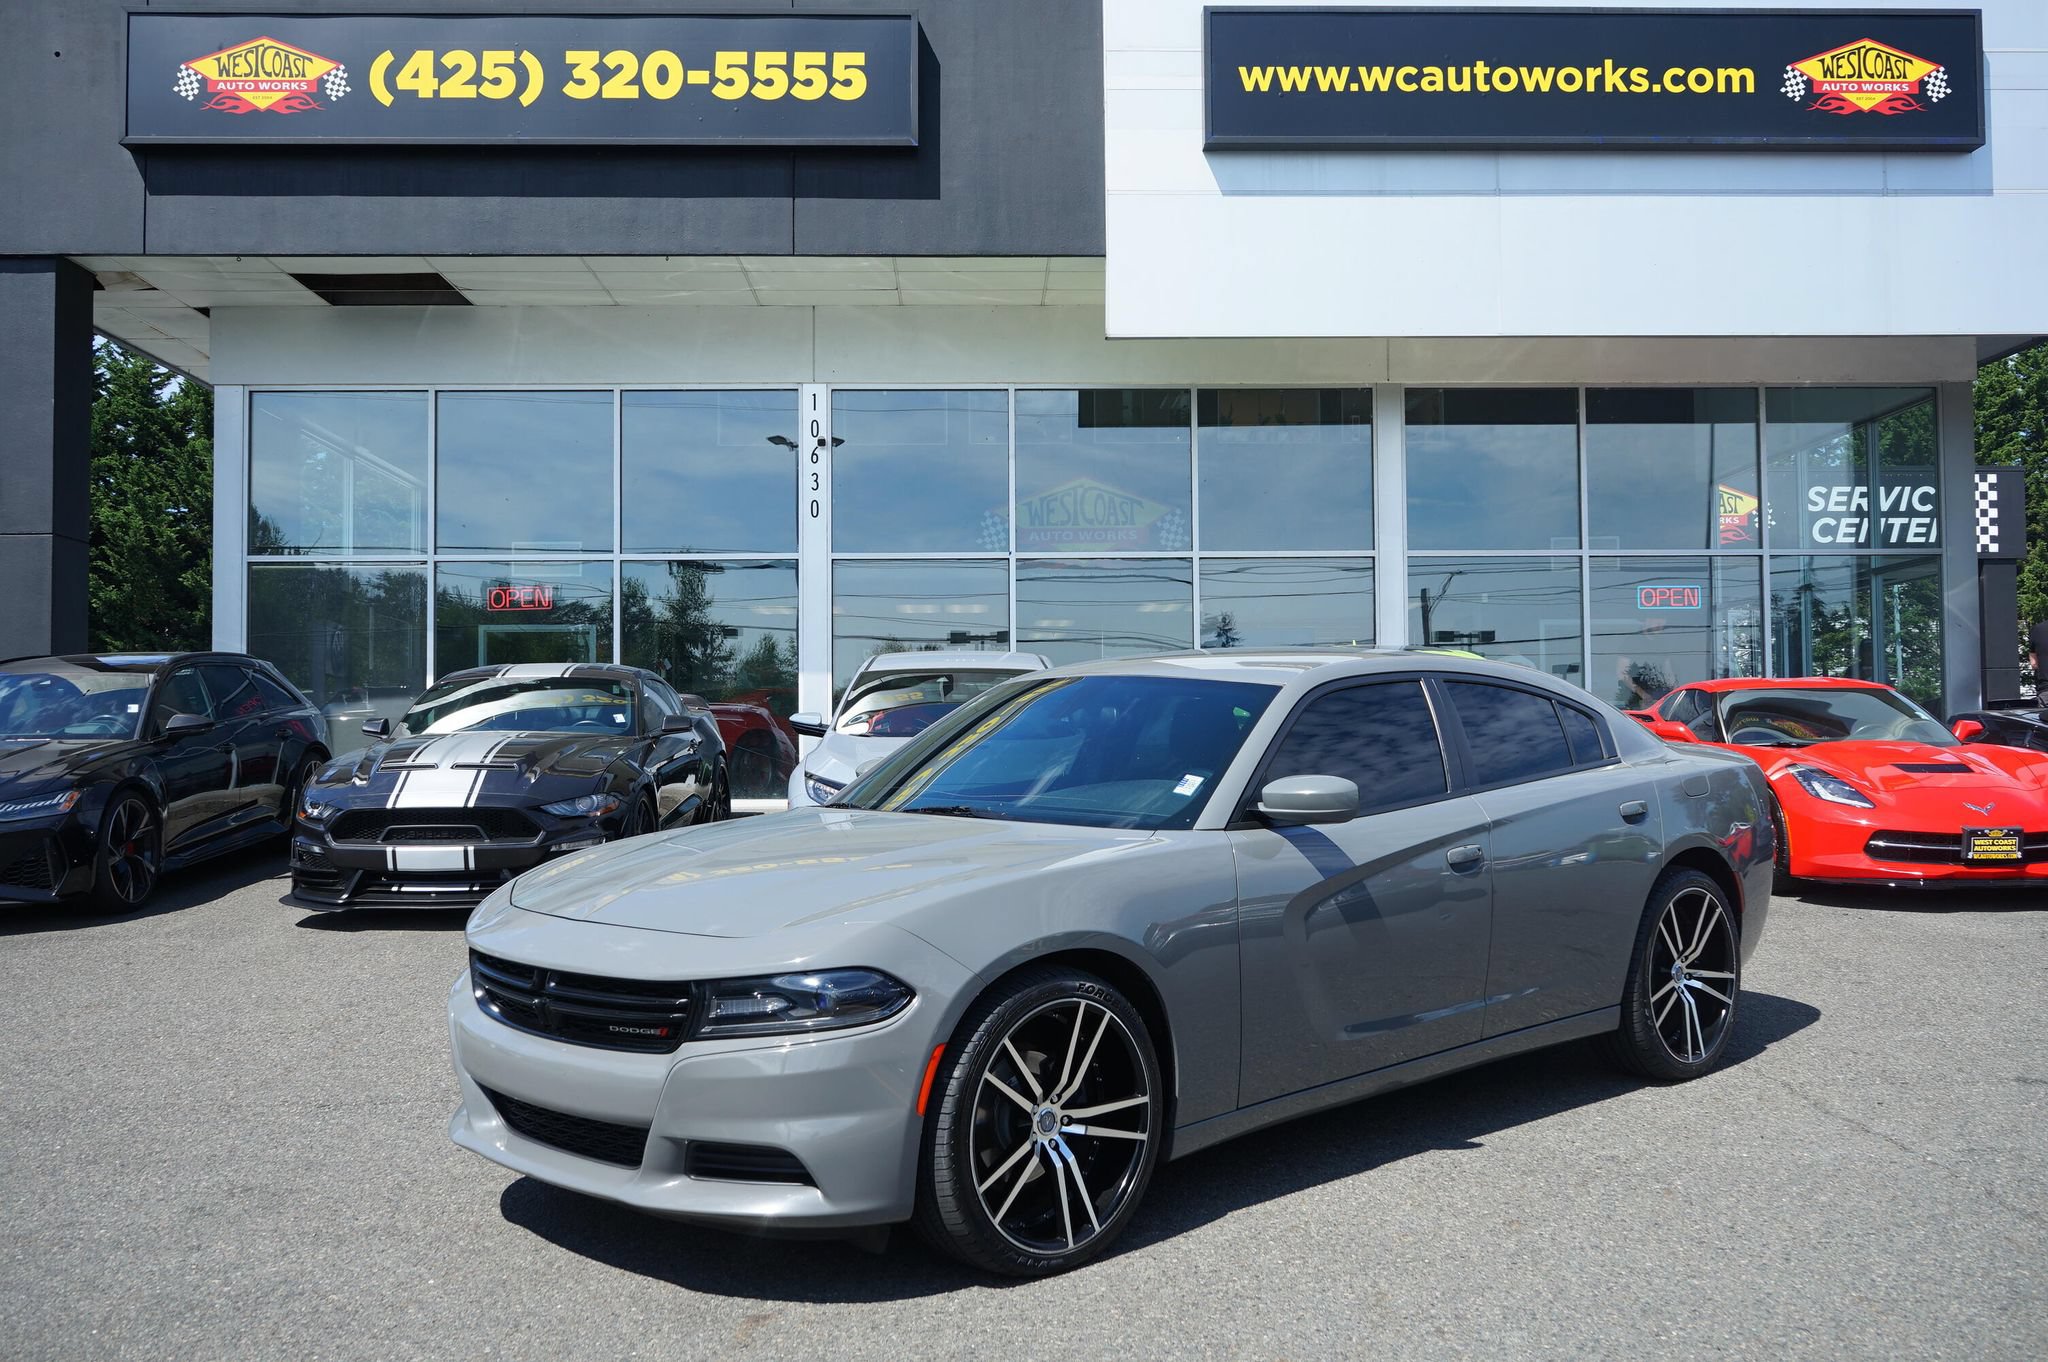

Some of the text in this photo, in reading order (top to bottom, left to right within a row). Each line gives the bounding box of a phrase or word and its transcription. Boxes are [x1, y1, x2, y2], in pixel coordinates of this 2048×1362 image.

[369, 49, 867, 107] (425) 320-5555
[1238, 59, 1755, 94] www.wcautoworks.com
[217, 82, 308, 90] AUTO WORKS
[1822, 83, 1909, 91] AUTO WORKS
[1029, 530, 1137, 541] AUTO WORKS
[490, 588, 549, 608] OPEN
[1641, 588, 1698, 607] OPEN
[609, 1025, 661, 1035] DODGE
